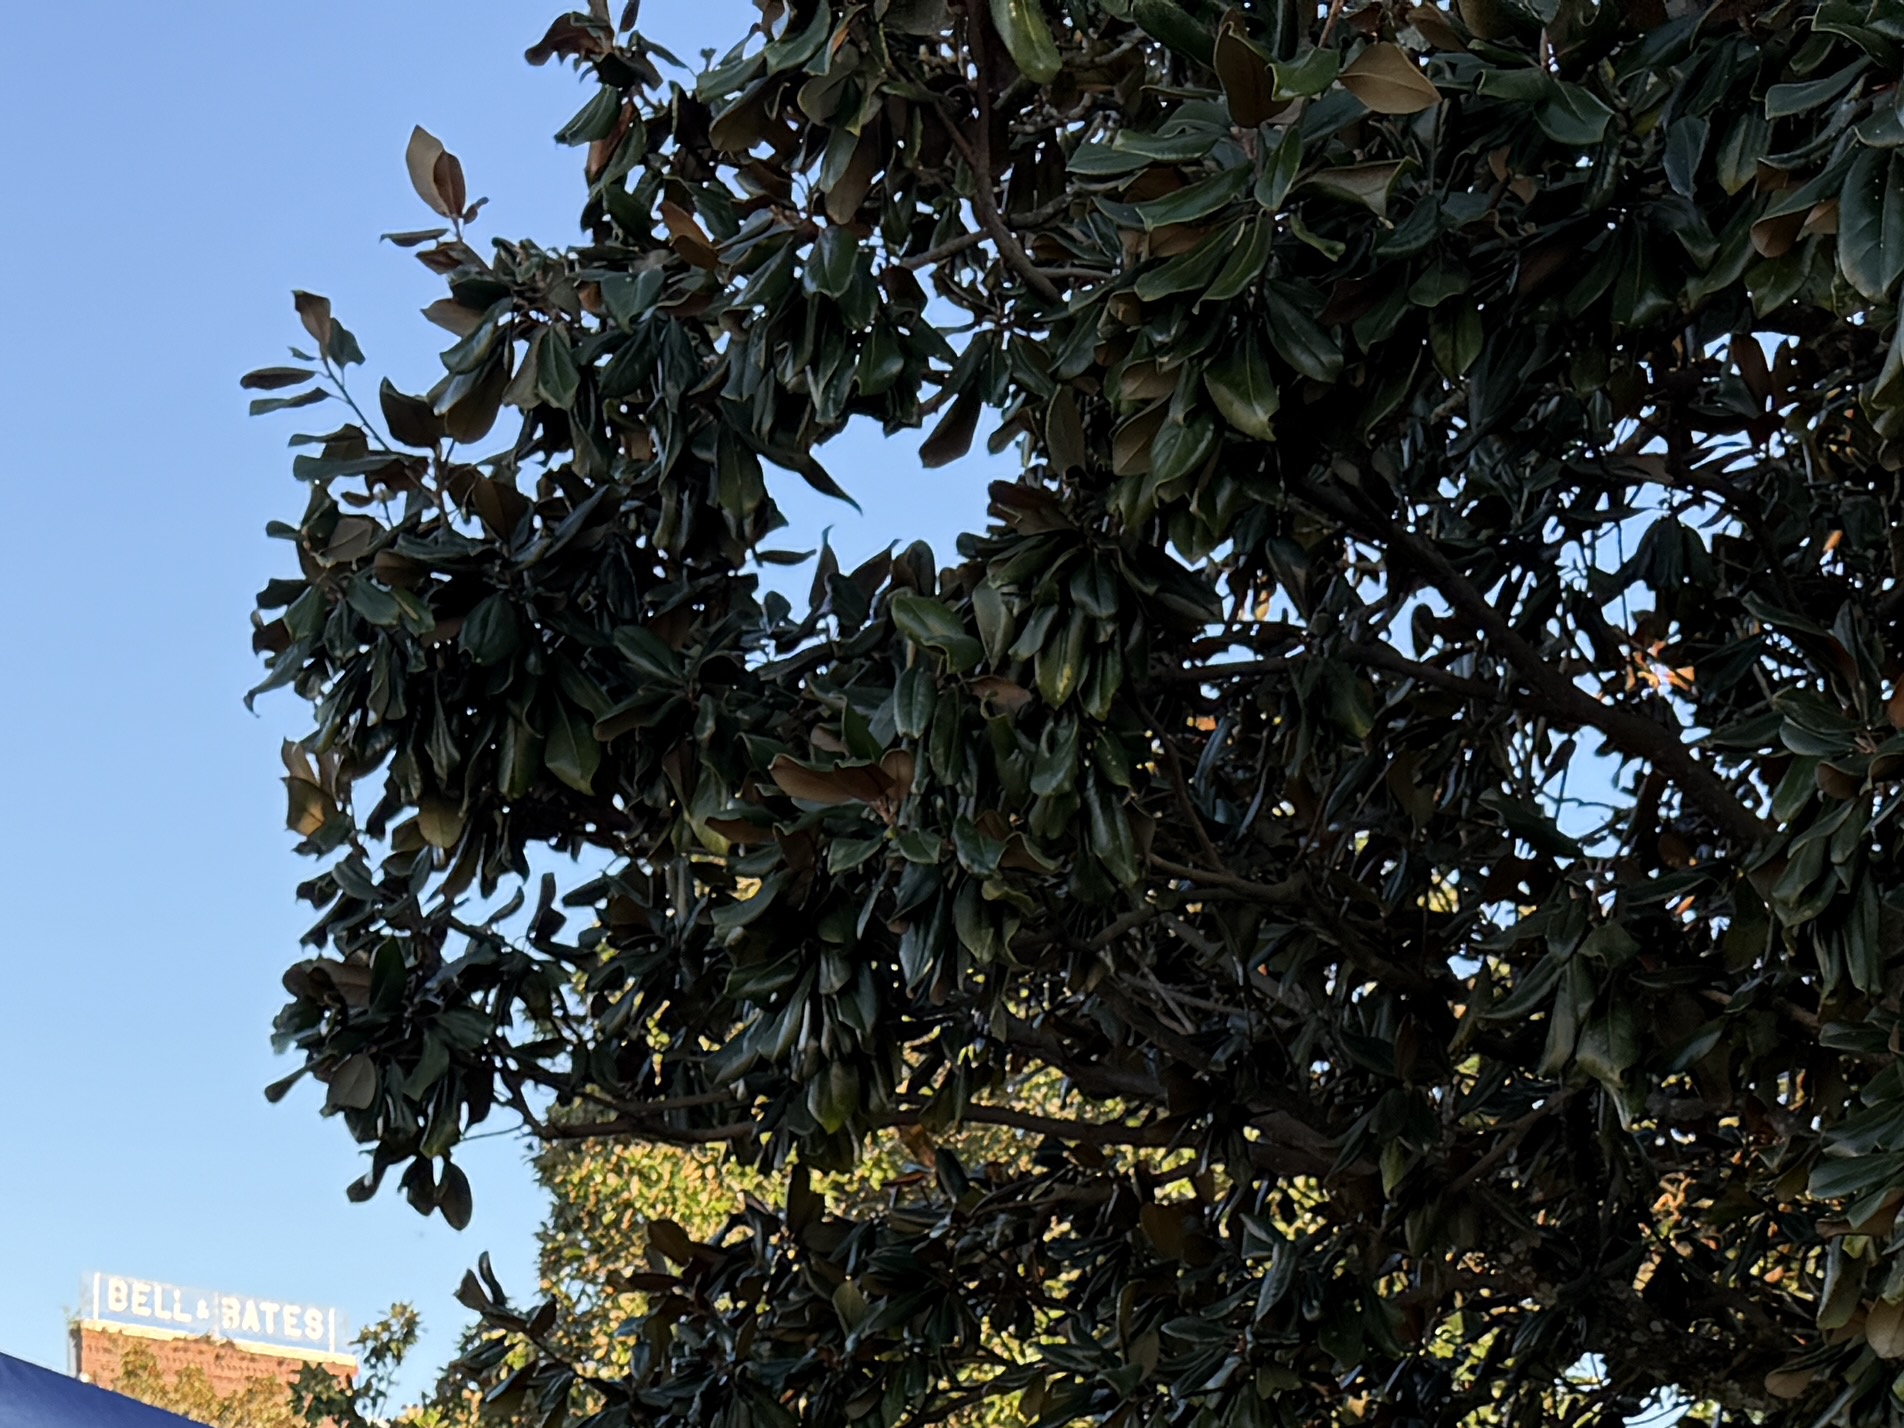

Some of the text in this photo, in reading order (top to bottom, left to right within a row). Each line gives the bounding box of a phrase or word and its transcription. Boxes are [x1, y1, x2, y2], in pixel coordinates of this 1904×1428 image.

[108, 1277, 324, 1340] BELL & BATES
